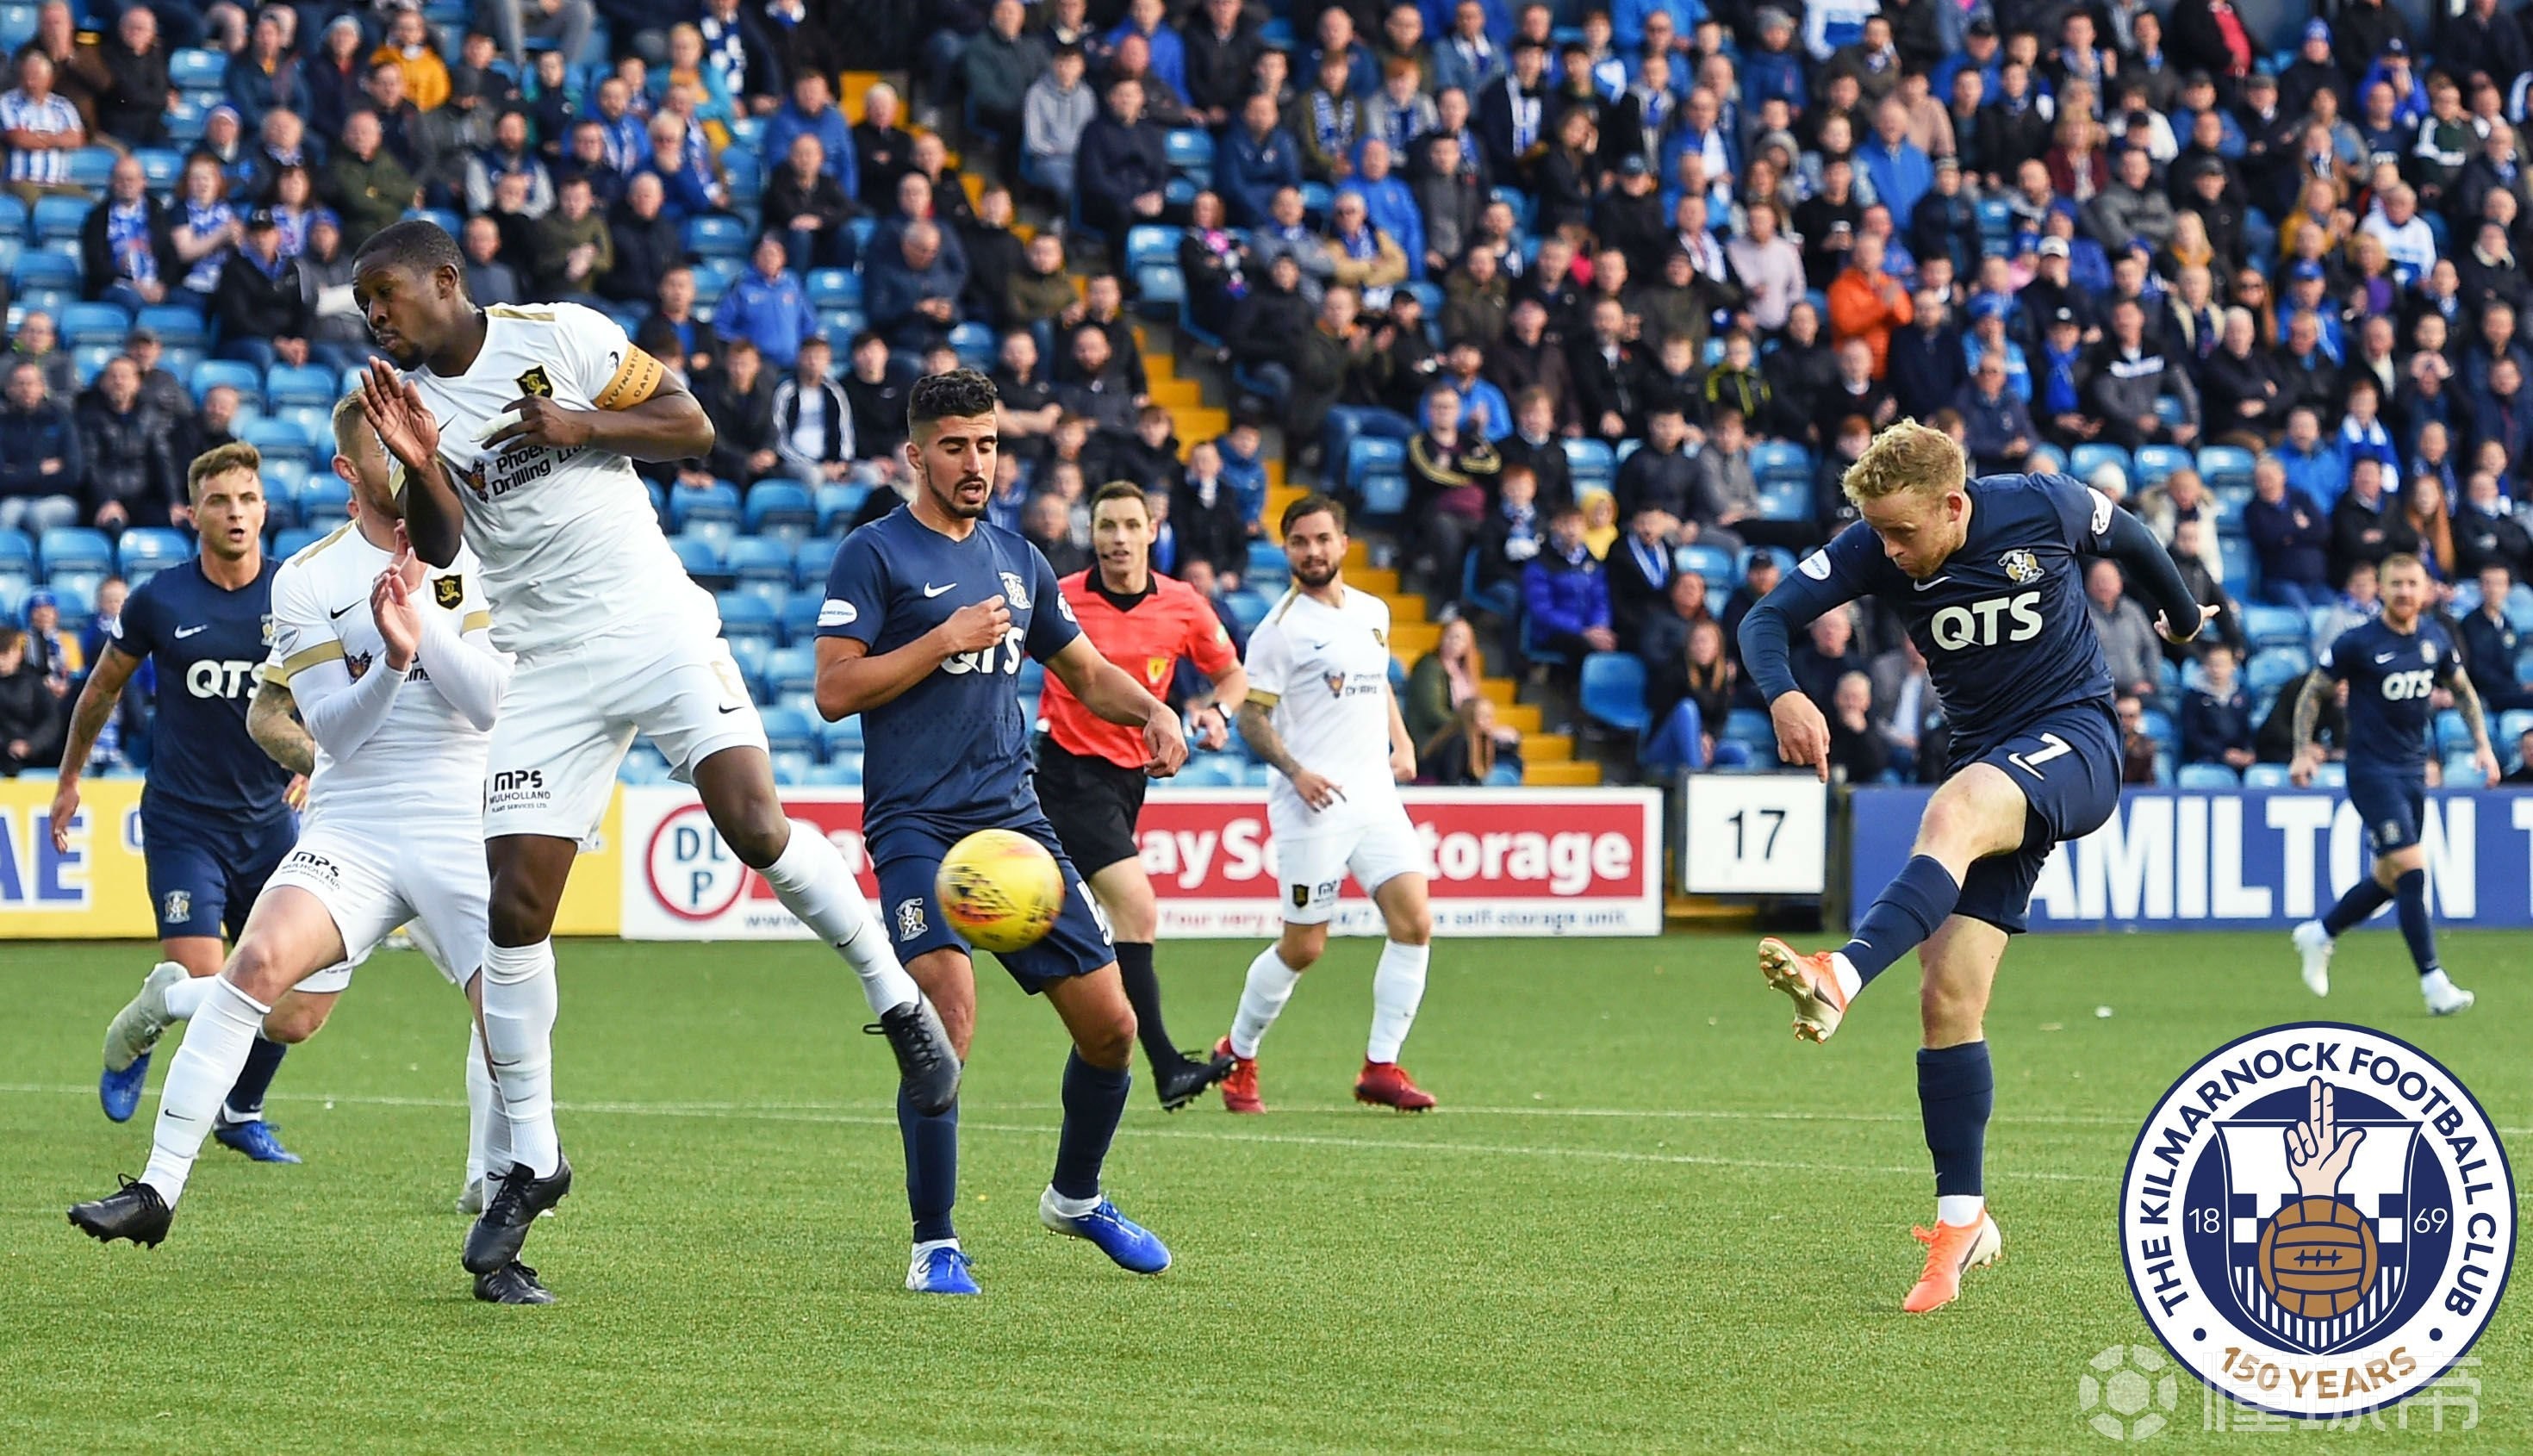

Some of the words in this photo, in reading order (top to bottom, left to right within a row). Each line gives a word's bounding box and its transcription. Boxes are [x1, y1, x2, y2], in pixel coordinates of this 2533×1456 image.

[633, 358, 655, 398] CAPTA
[491, 457, 551, 496] Drilling
[1930, 591, 2043, 651] QTS
[2381, 669, 2434, 701] QTS
[2024, 731, 2072, 767] 7
[489, 791, 551, 805] MULHOLLAND
[494, 769, 543, 793] MPS
[1727, 808, 1787, 861] 17
[292, 850, 339, 877] MPS
[1417, 821, 1634, 896] torage
[2028, 796, 2476, 920] AMILTON
